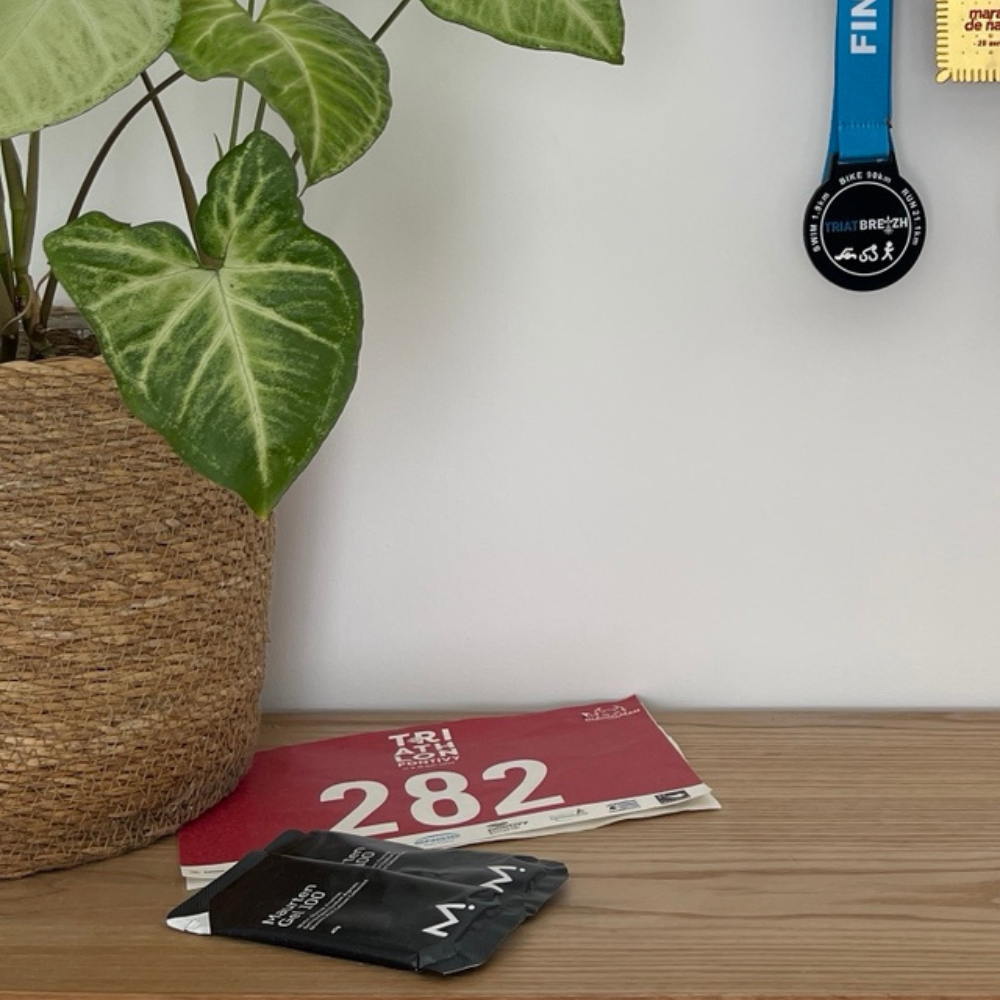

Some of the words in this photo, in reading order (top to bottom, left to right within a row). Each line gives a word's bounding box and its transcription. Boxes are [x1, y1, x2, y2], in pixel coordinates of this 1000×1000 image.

[964, 20, 982, 31] de
[839, 171, 863, 185] BIKE
[901, 188, 919, 209] RUN
[810, 224, 820, 252] SWIM
[320, 759, 565, 837] 282
[261, 884, 317, 925] Maurten
[278, 909, 306, 927] Gel
[299, 891, 326, 912] 100
